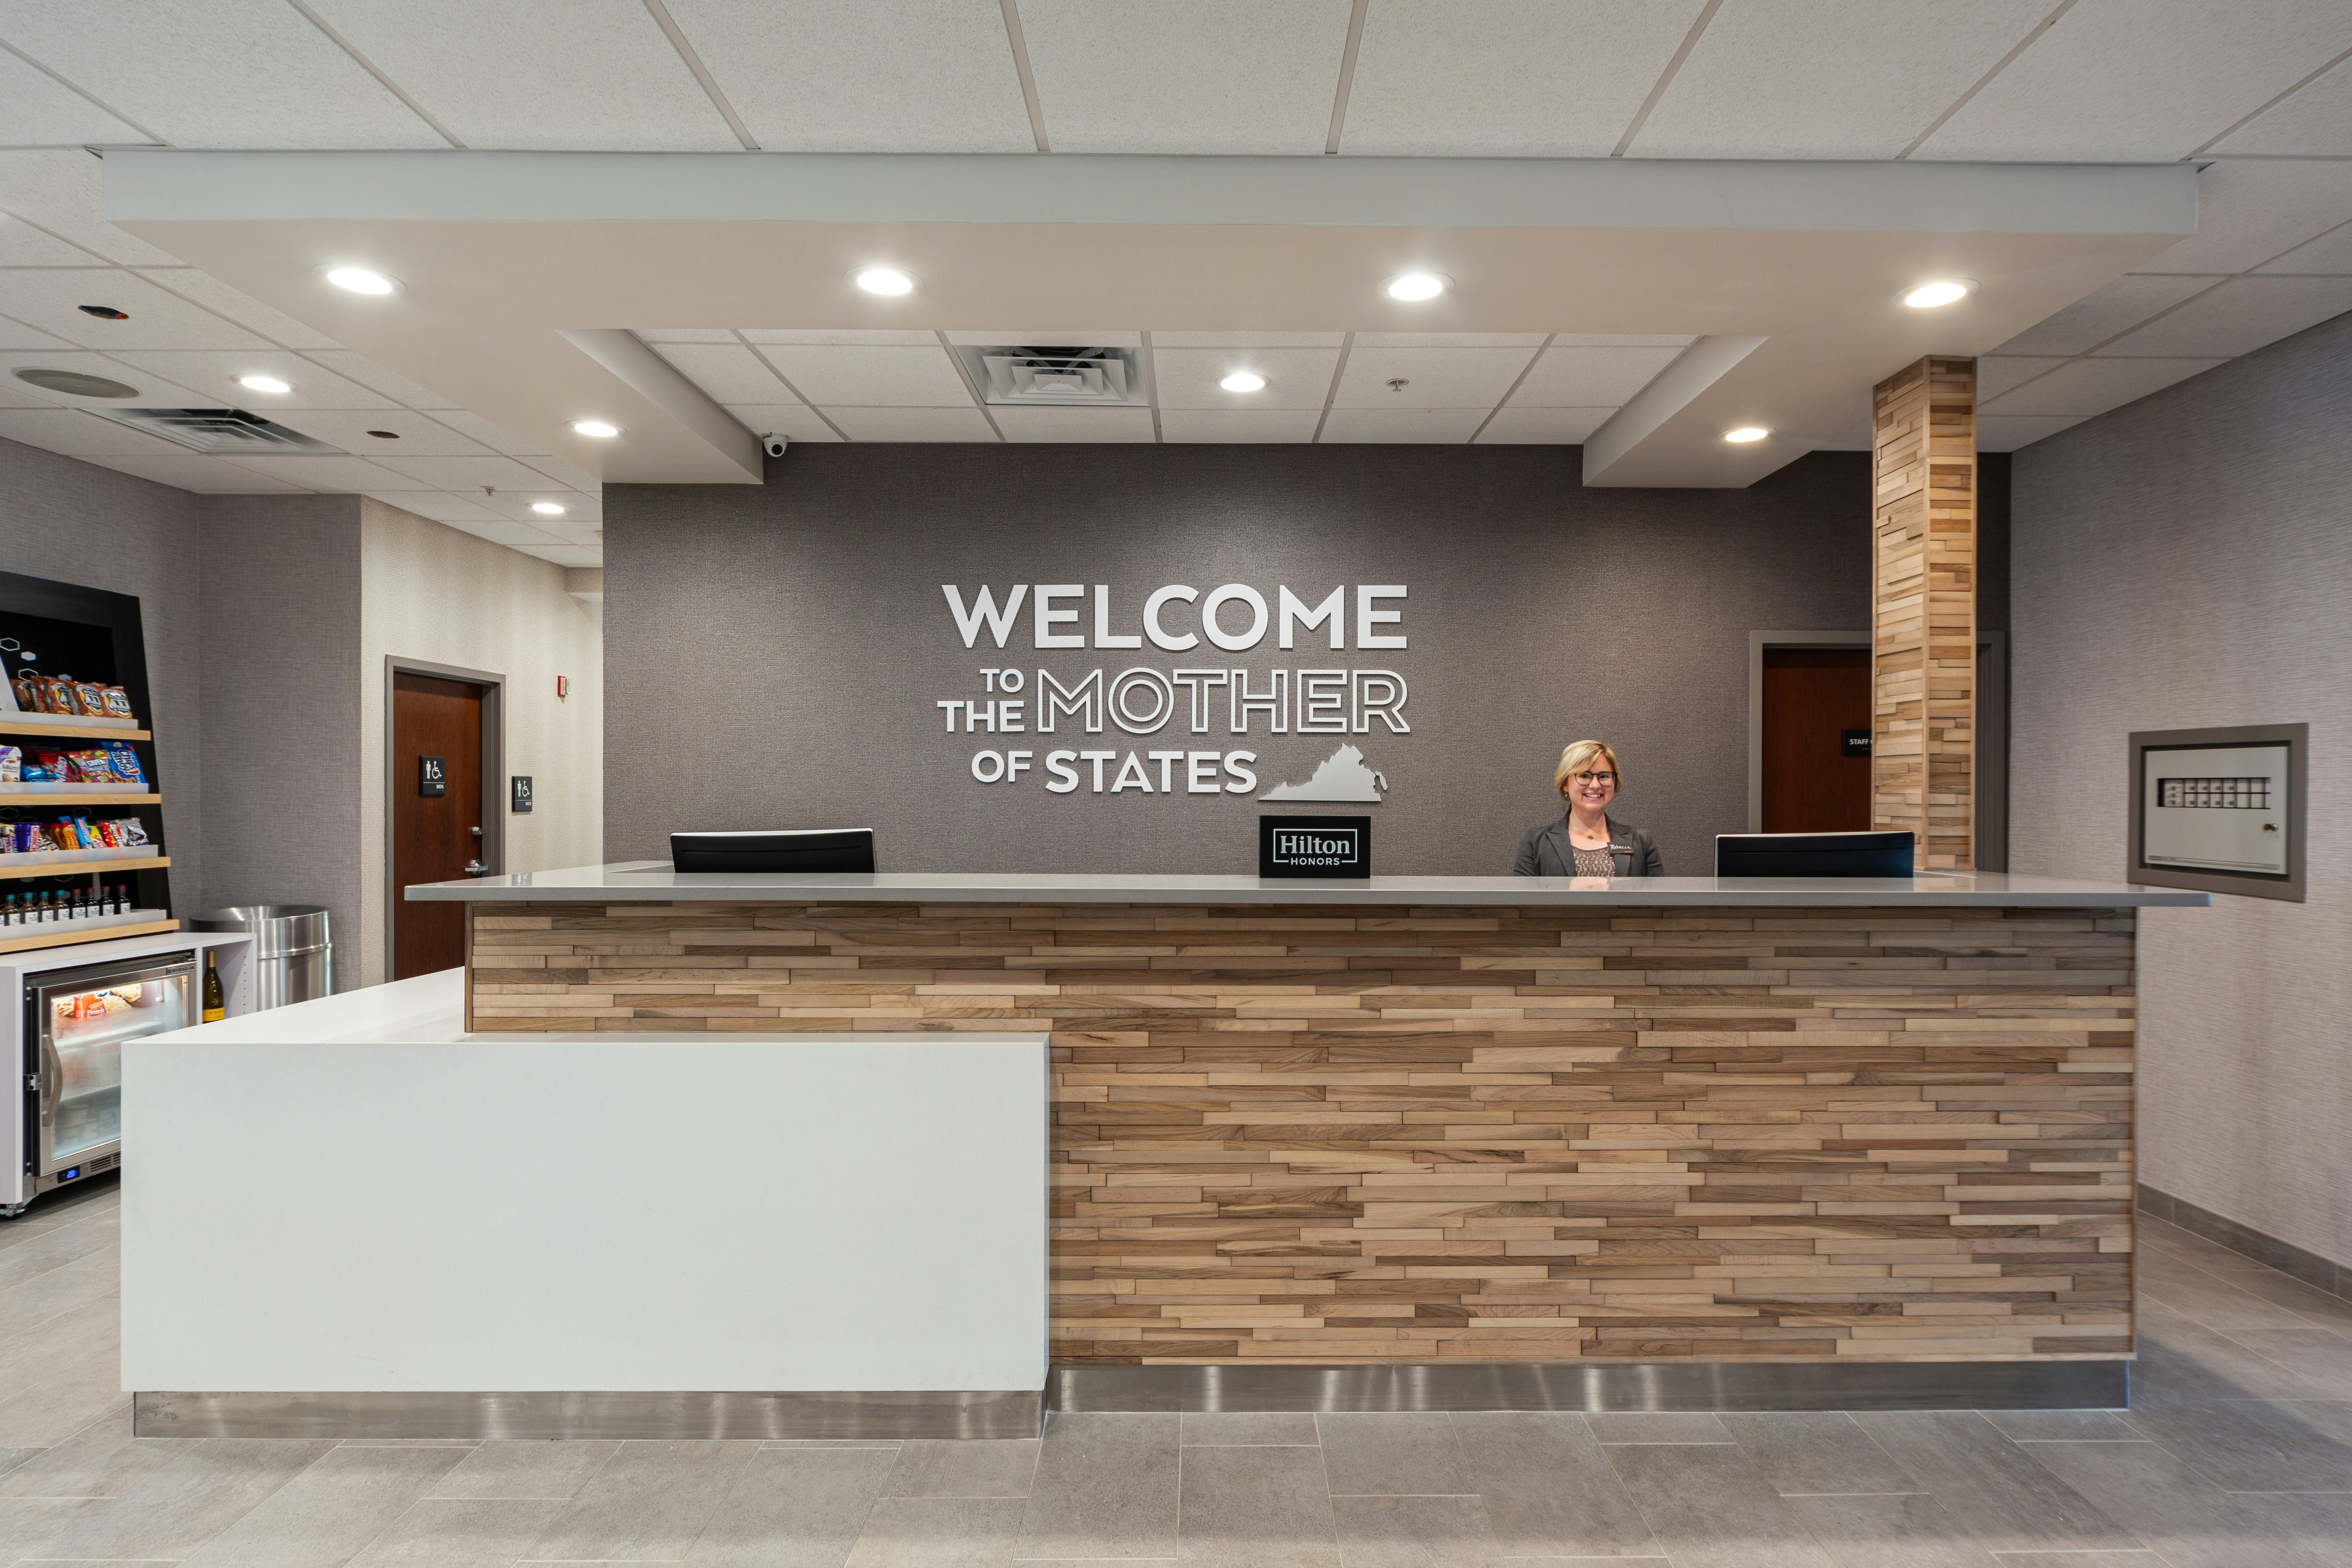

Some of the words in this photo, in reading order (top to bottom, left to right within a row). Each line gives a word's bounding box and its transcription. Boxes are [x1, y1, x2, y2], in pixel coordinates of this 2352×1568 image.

[941, 583, 1408, 650] WELCOME
[979, 668, 1025, 693] TO
[1038, 667, 1410, 734] MOTHER
[937, 700, 1025, 732] THE
[111, 752, 139, 774] Ahoy!
[118, 749, 136, 770] Chips
[971, 750, 1033, 783] OF
[1045, 749, 1257, 793] STATES
[31, 826, 39, 852] CRUNCH
[1280, 835, 1351, 854] Hilton
